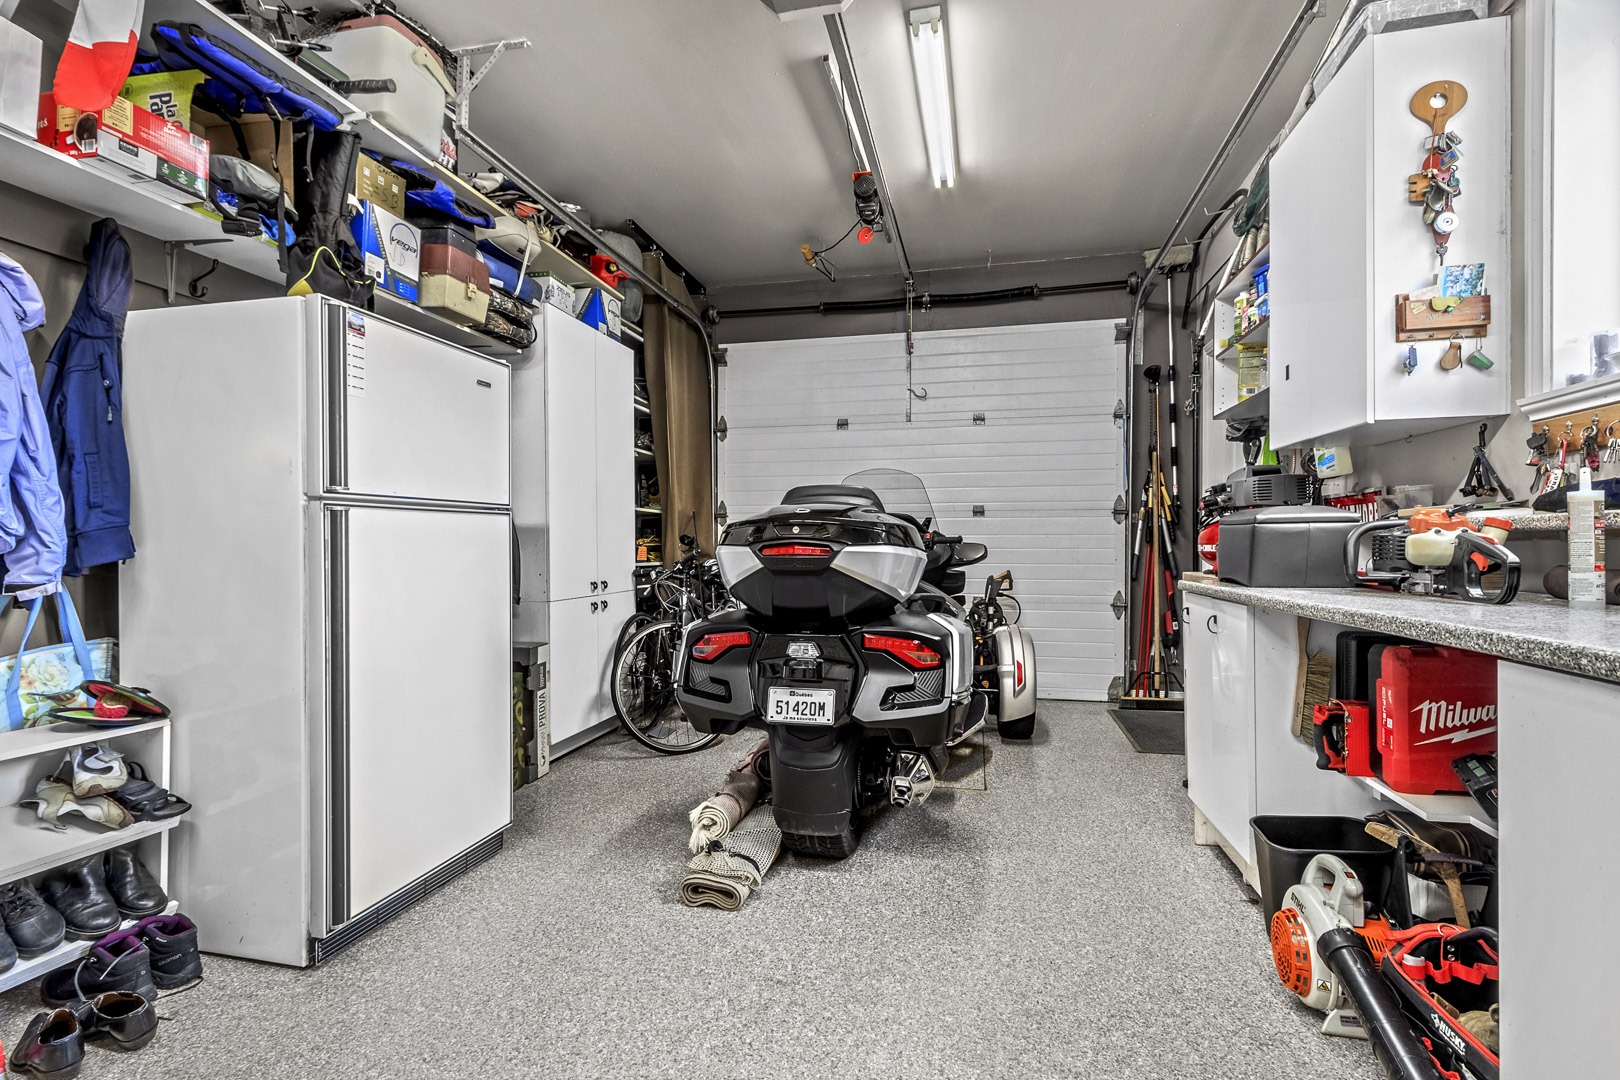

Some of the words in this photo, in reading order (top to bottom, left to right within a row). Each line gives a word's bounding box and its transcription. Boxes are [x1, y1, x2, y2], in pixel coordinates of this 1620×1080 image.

[391, 236, 418, 254] vega
[538, 691, 546, 728] PROVA
[776, 700, 826, 717] 51420M
[1290, 891, 1306, 915] STIHL
[1439, 1020, 1466, 1052] HUSKY
